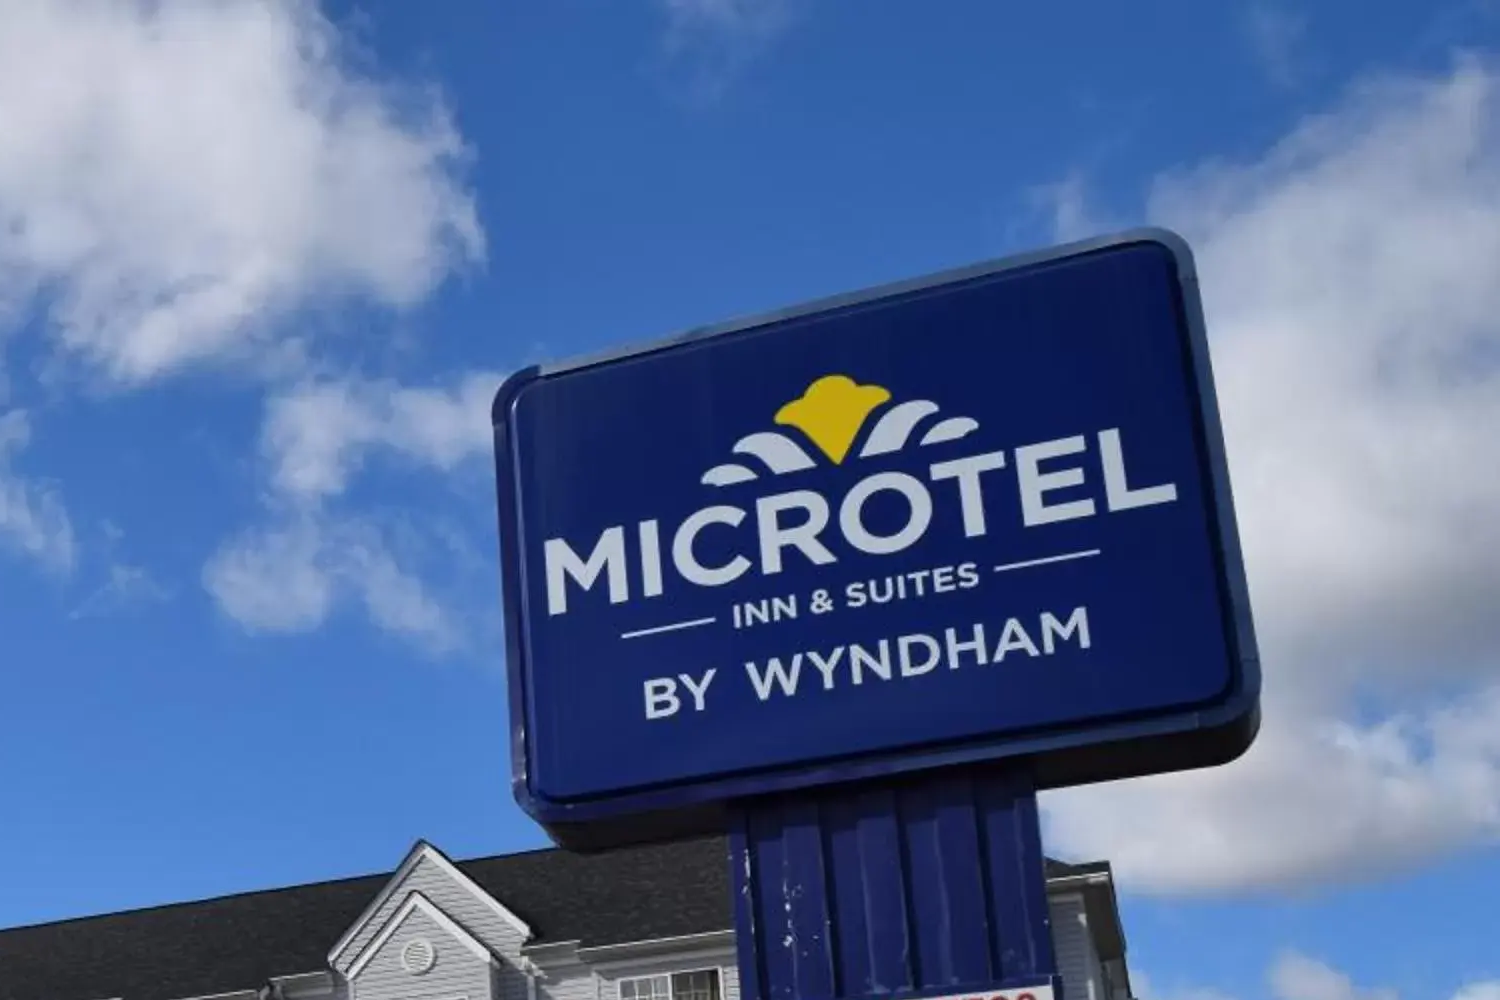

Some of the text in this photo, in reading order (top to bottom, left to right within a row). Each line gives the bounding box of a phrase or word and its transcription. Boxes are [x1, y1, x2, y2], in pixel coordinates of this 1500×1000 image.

[544, 427, 1177, 616] MICROTEL
[732, 562, 979, 630] INN & SUITES
[643, 606, 1091, 720] BY WYNDHAM
